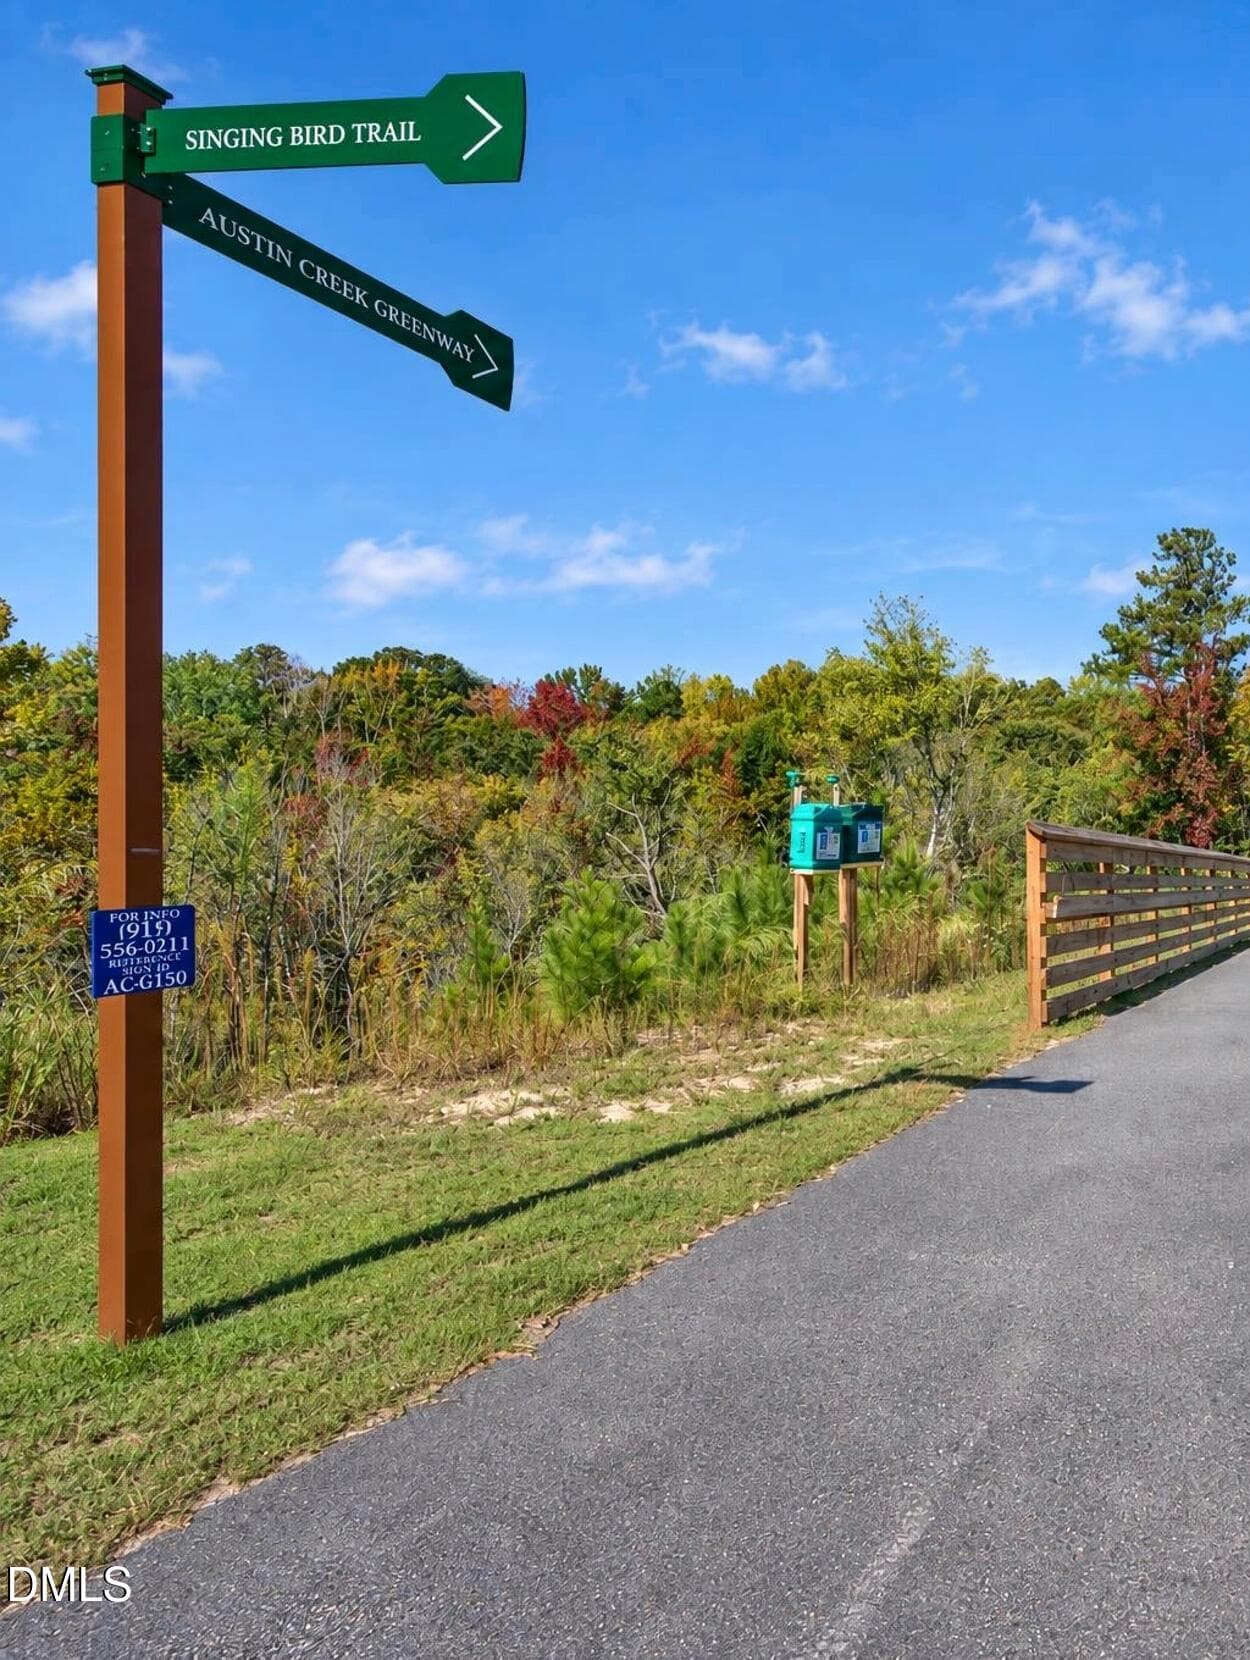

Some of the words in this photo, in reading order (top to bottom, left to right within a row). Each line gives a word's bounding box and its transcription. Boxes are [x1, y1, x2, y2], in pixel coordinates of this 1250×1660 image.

[185, 126, 283, 150] SINGING
[289, 125, 345, 146] BIRD
[351, 121, 421, 144] TRAIL
[199, 207, 293, 268] AUSTIN
[299, 259, 368, 308] CREEK
[374, 299, 475, 363] GREENWAY
[110, 912, 140, 923] FOR
[144, 909, 180, 920] INFO
[119, 919, 172, 941] (919)
[100, 936, 189, 959] 556-0211
[103, 970, 187, 995] AC-G150
